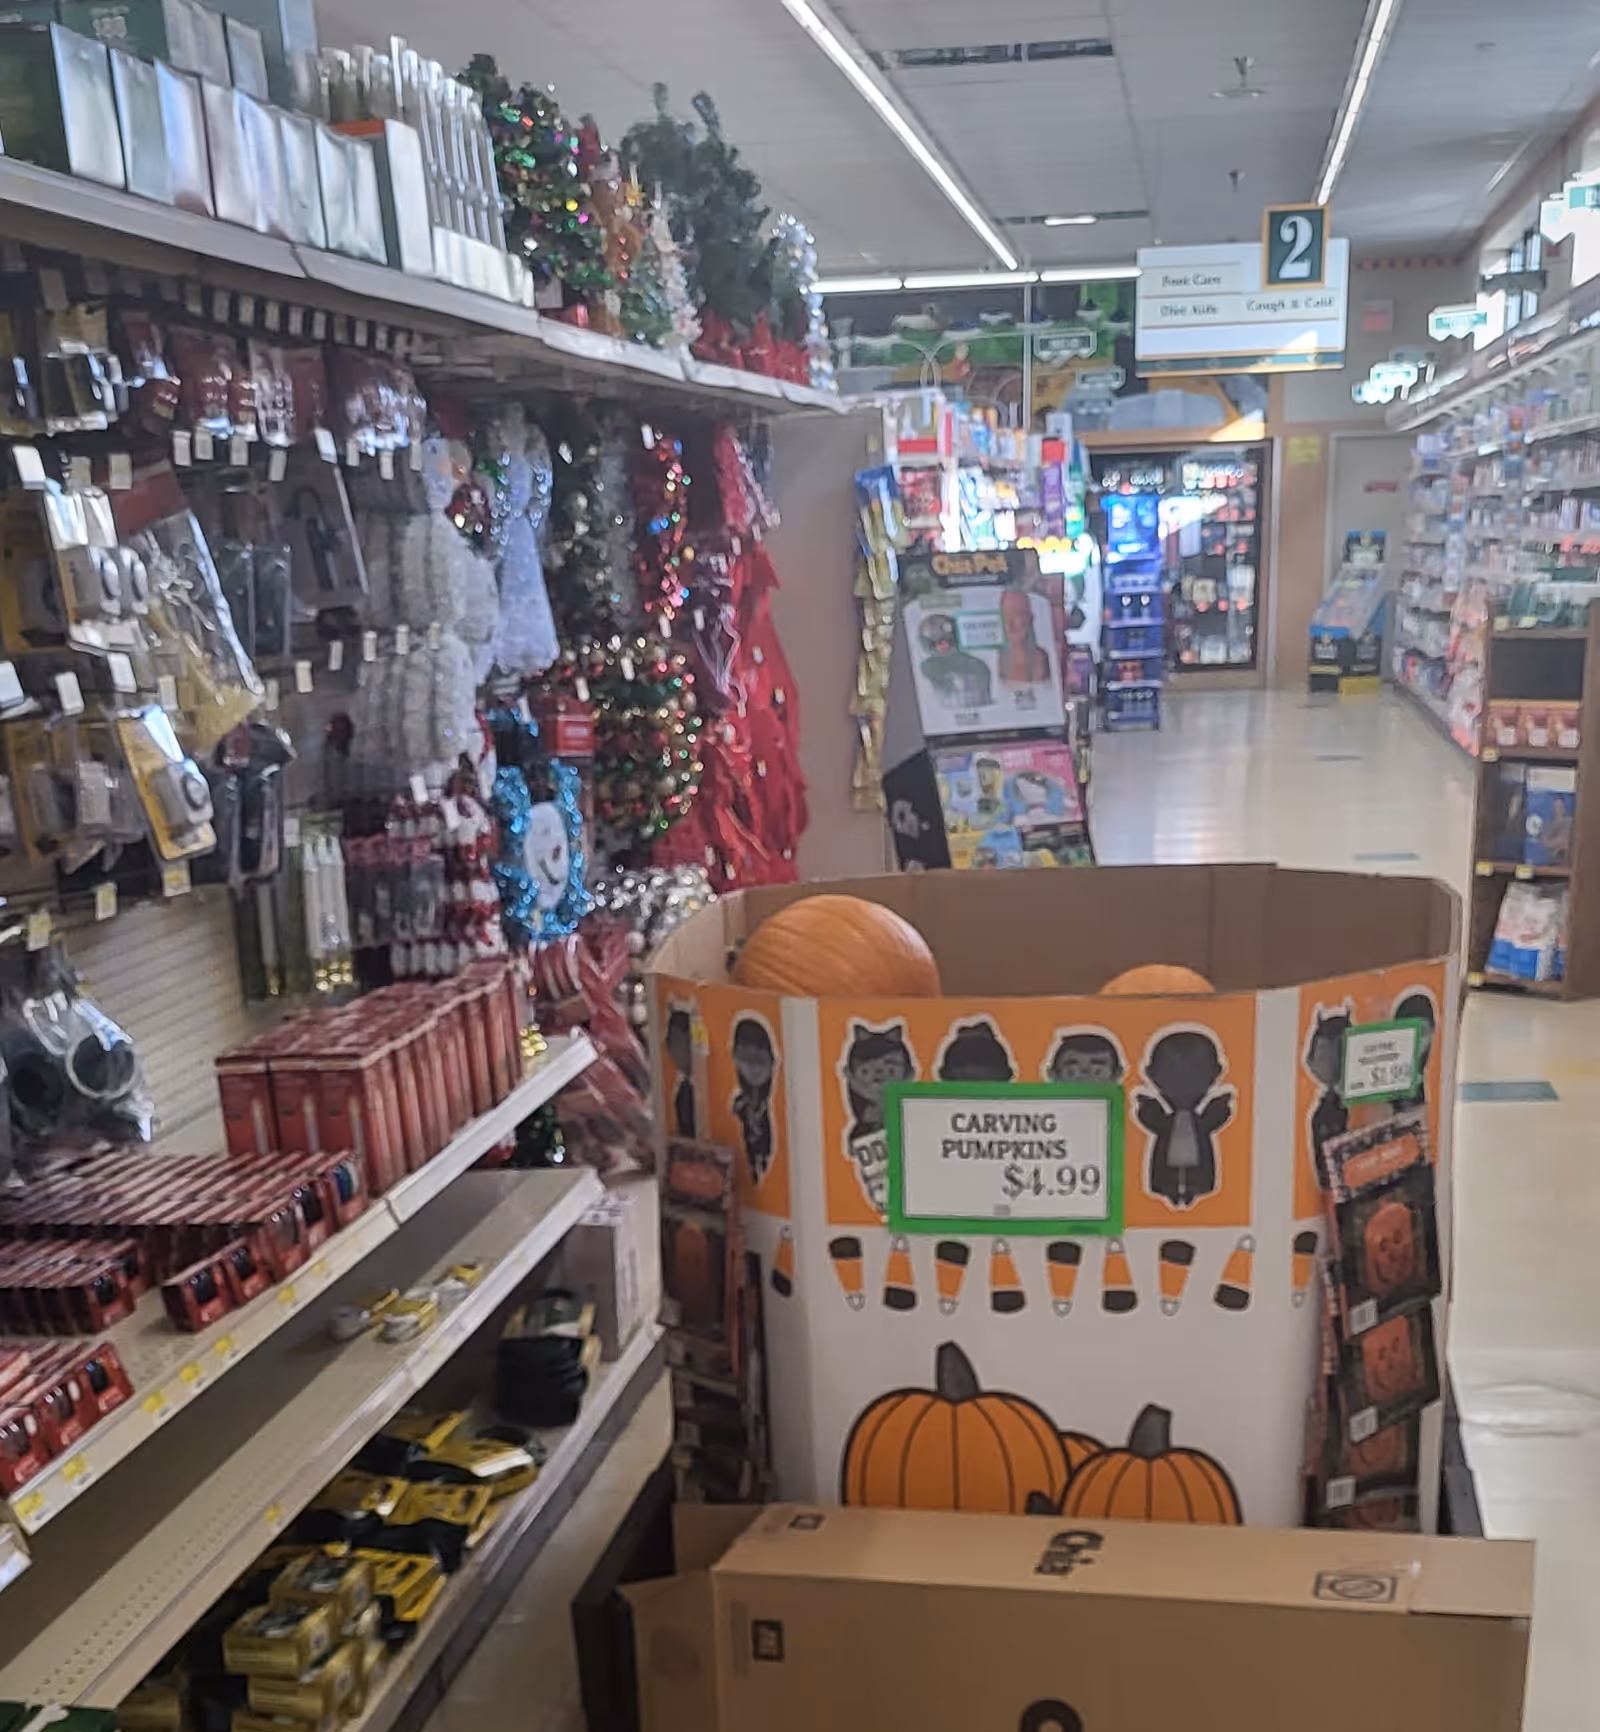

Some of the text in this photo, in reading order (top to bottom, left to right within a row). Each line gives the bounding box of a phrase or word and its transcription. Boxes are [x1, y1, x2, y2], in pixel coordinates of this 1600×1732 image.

[1278, 215, 1313, 279] 2
[1246, 300, 1286, 313] Cough
[1304, 297, 1335, 309] Cold
[949, 1113, 1057, 1133] CARVING
[940, 1139, 1068, 1160] PUMPKINS
[1002, 1163, 1101, 1199] $4.99
[1034, 1529, 1105, 1577] Chia
